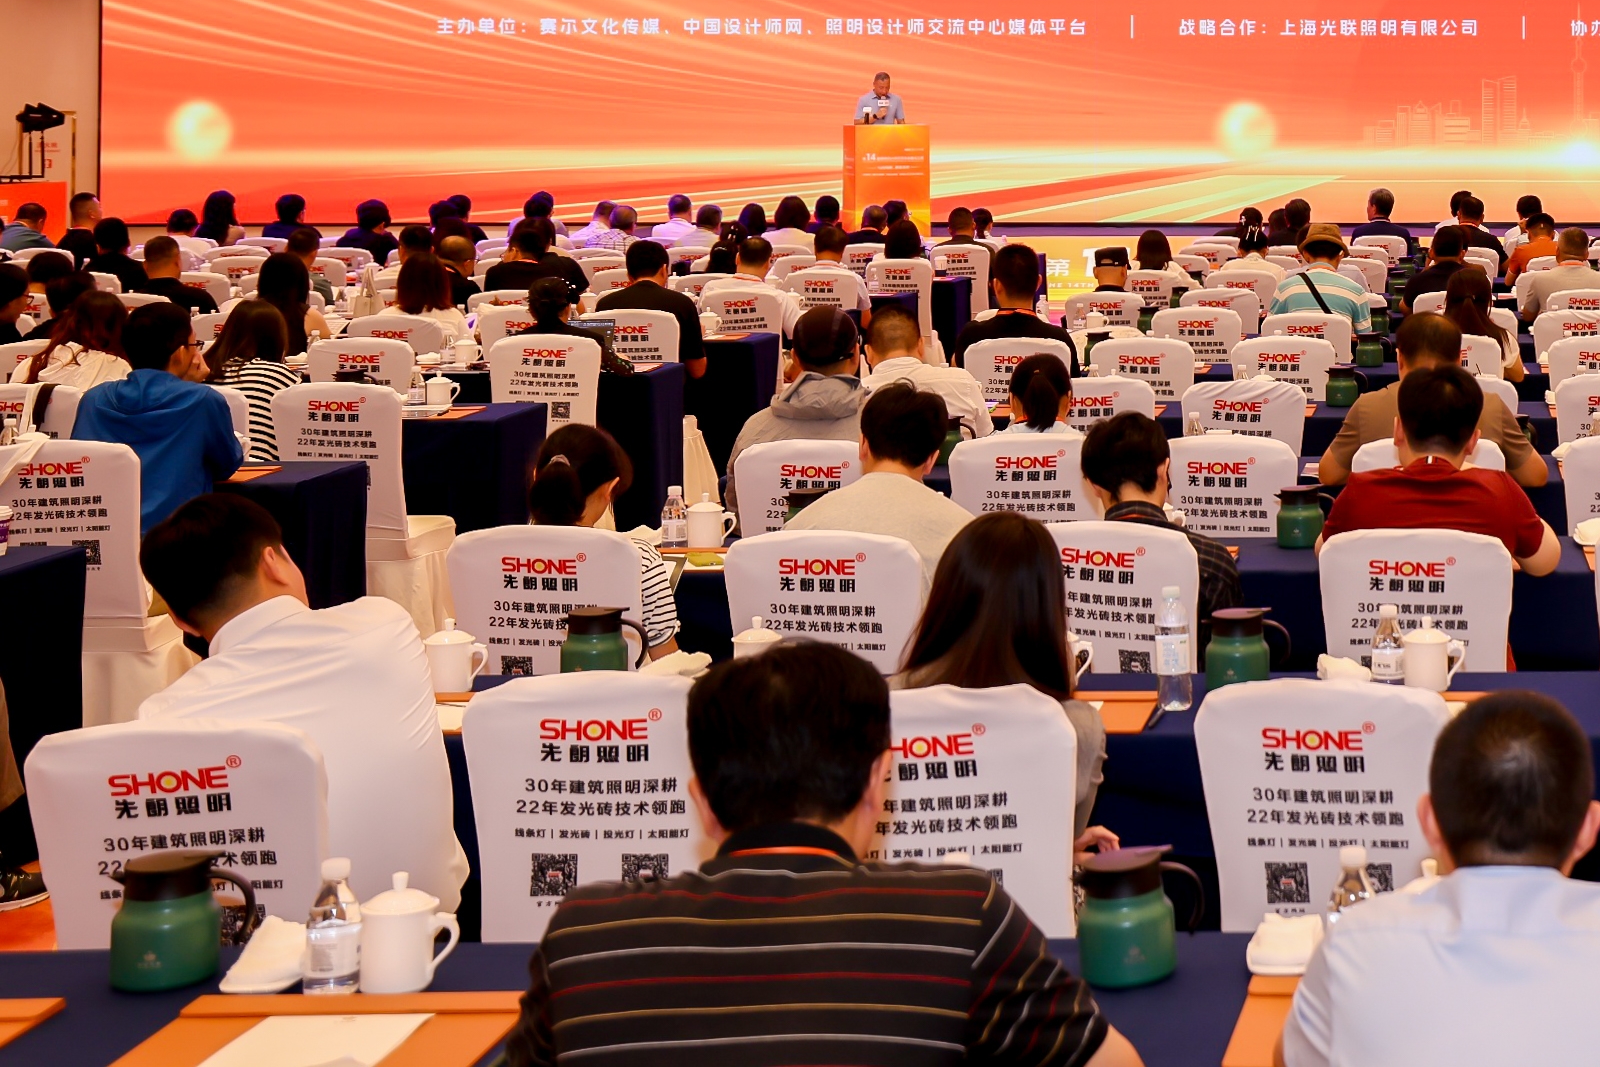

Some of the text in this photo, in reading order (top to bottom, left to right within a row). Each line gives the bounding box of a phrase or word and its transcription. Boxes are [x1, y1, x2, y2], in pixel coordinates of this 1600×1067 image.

[11, 495, 102, 508] 30年建筑照明深耕
[986, 490, 1072, 501] 30年建筑照明深耕
[1180, 495, 1263, 507] 30年建筑照明深耕
[981, 502, 1076, 513] 22年发光砖技术领跑
[770, 603, 876, 618] 30年建筑照明深耕
[765, 619, 883, 634] 22年发光砖技术领跑
[889, 733, 975, 760] HONE
[524, 776, 678, 796] 30年建筑照明深耕
[882, 791, 1008, 814] 年建筑照明深耕
[1253, 786, 1394, 806] 30年建筑照明深耕
[516, 798, 687, 817] 22年发光砖技术领跑
[875, 813, 1018, 836] 年发光砖技术领跑
[1246, 808, 1405, 827] 22年发光砖技术领跑
[103, 827, 265, 852] 30年建筑照明深耕
